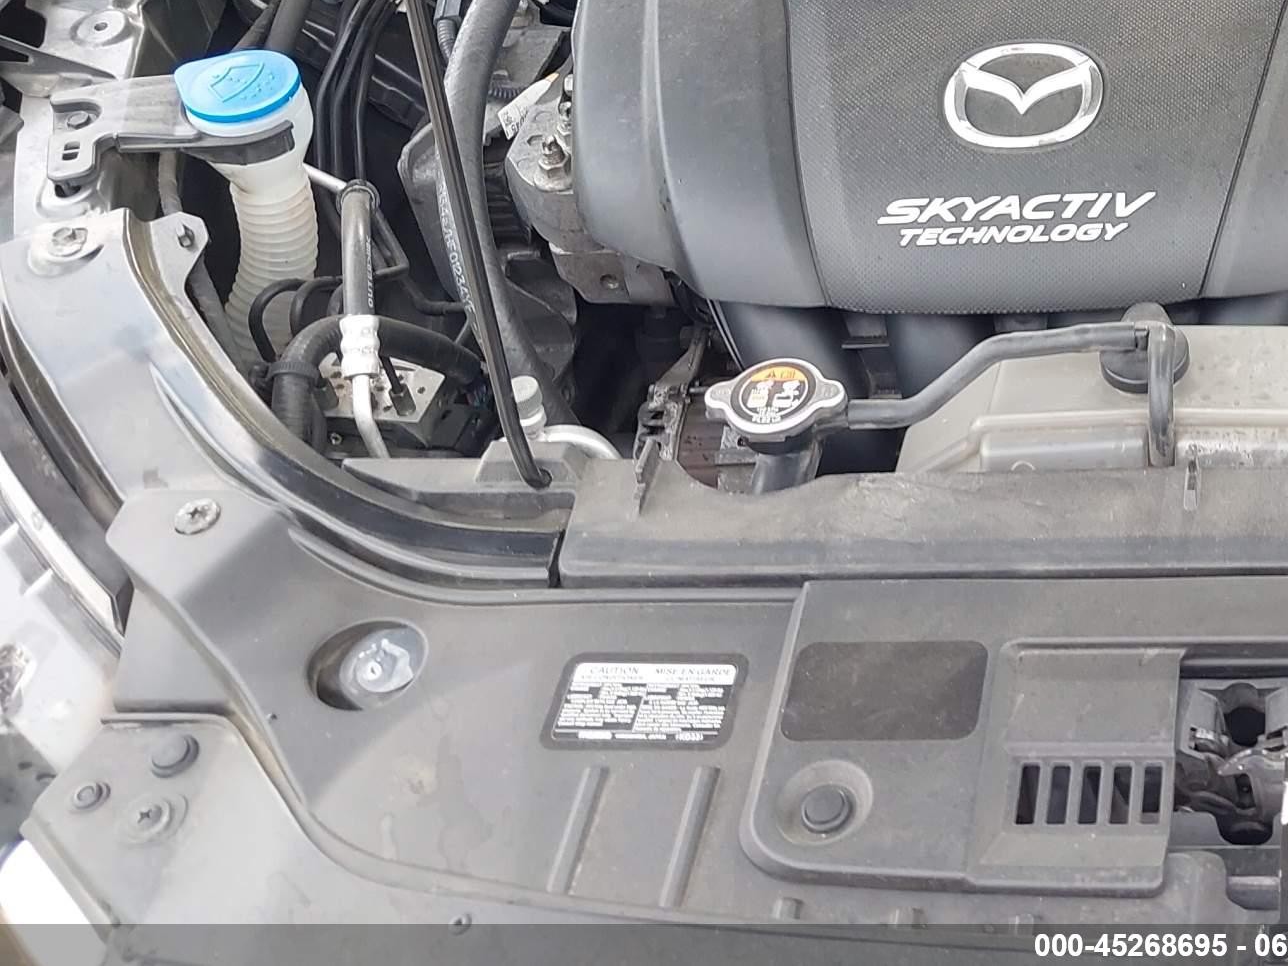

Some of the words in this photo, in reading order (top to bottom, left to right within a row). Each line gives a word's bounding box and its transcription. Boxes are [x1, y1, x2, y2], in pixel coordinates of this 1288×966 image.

[876, 191, 1157, 225] SKYACTIV
[899, 222, 1130, 247] TECHNOLOGY
[589, 666, 640, 675] CAUTION
[655, 667, 677, 675] MISE
[696, 668, 731, 676] GARDE
